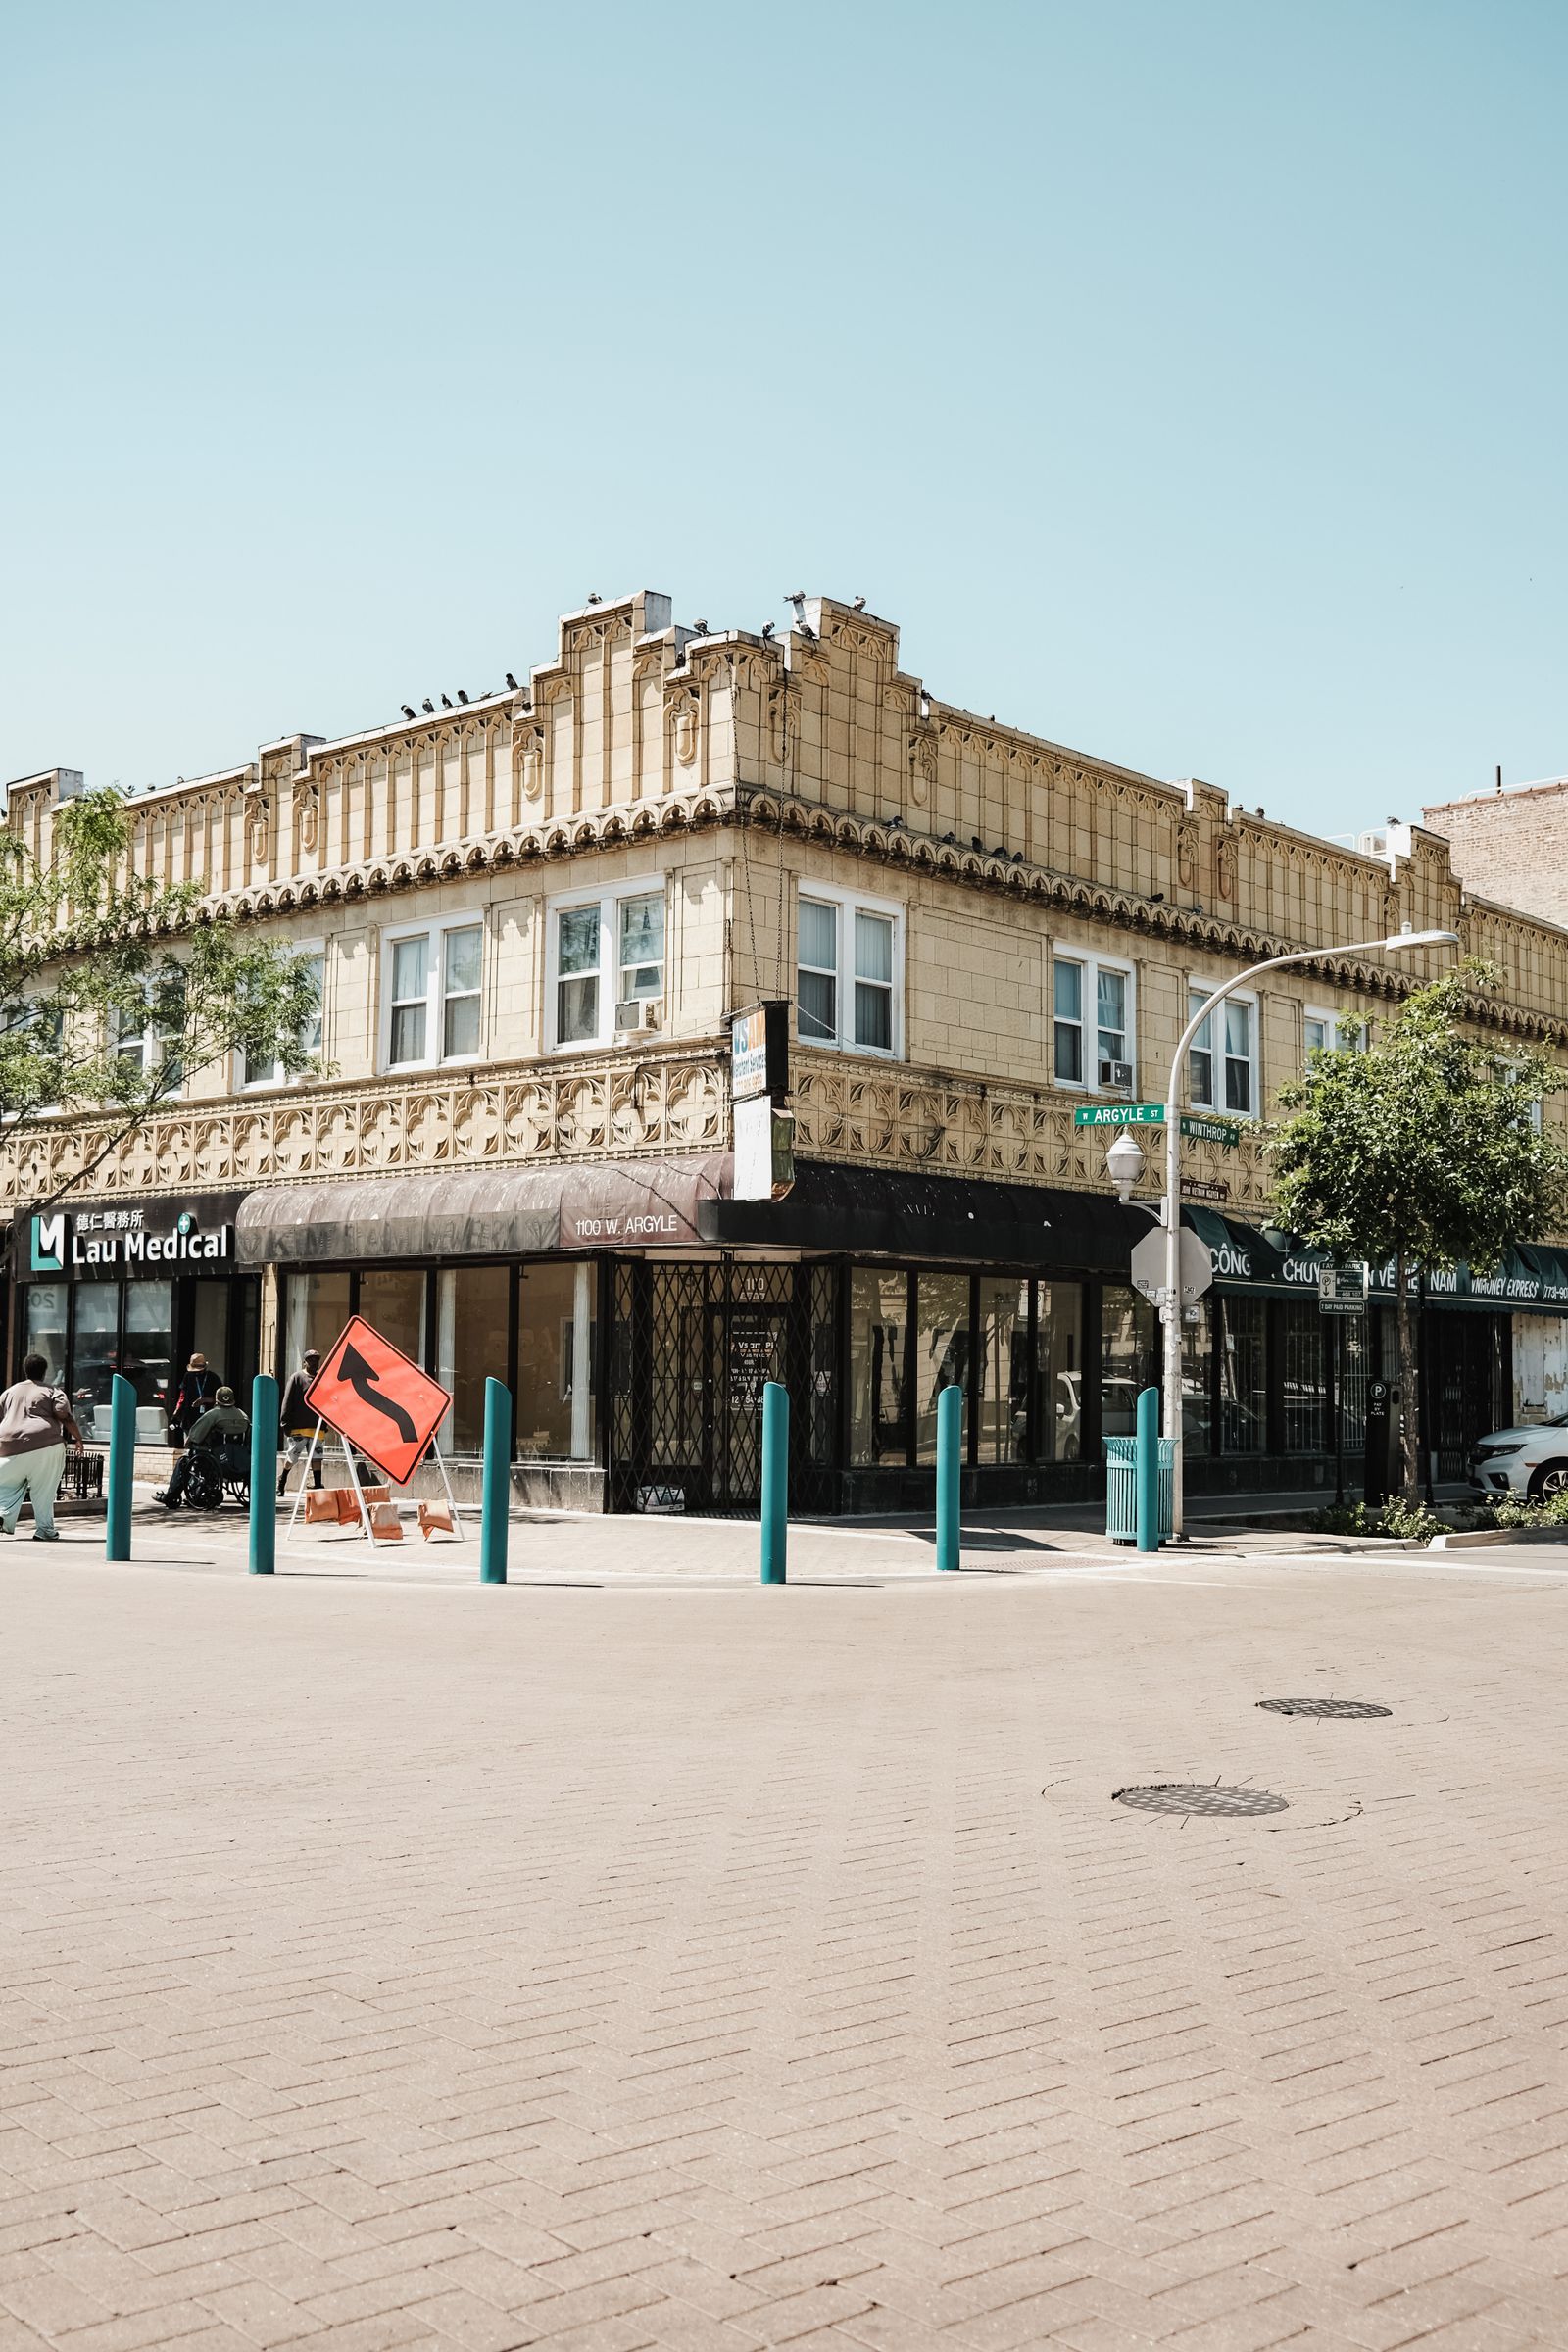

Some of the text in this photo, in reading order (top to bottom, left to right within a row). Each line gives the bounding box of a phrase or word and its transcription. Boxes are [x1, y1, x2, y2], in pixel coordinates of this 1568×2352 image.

[1094, 1107, 1145, 1123] ARGYLE
[1150, 1109, 1159, 1118] ST
[1189, 1120, 1227, 1141] WINTHROP
[76, 1209, 144, 1231] 德仁醫務所
[576, 1214, 677, 1236] 1100 W. ARGYLE
[73, 1235, 117, 1264] Lau
[124, 1224, 227, 1262] Medical
[1431, 1270, 1457, 1292] NAM
[1507, 1278, 1540, 1298] EXPRESS
